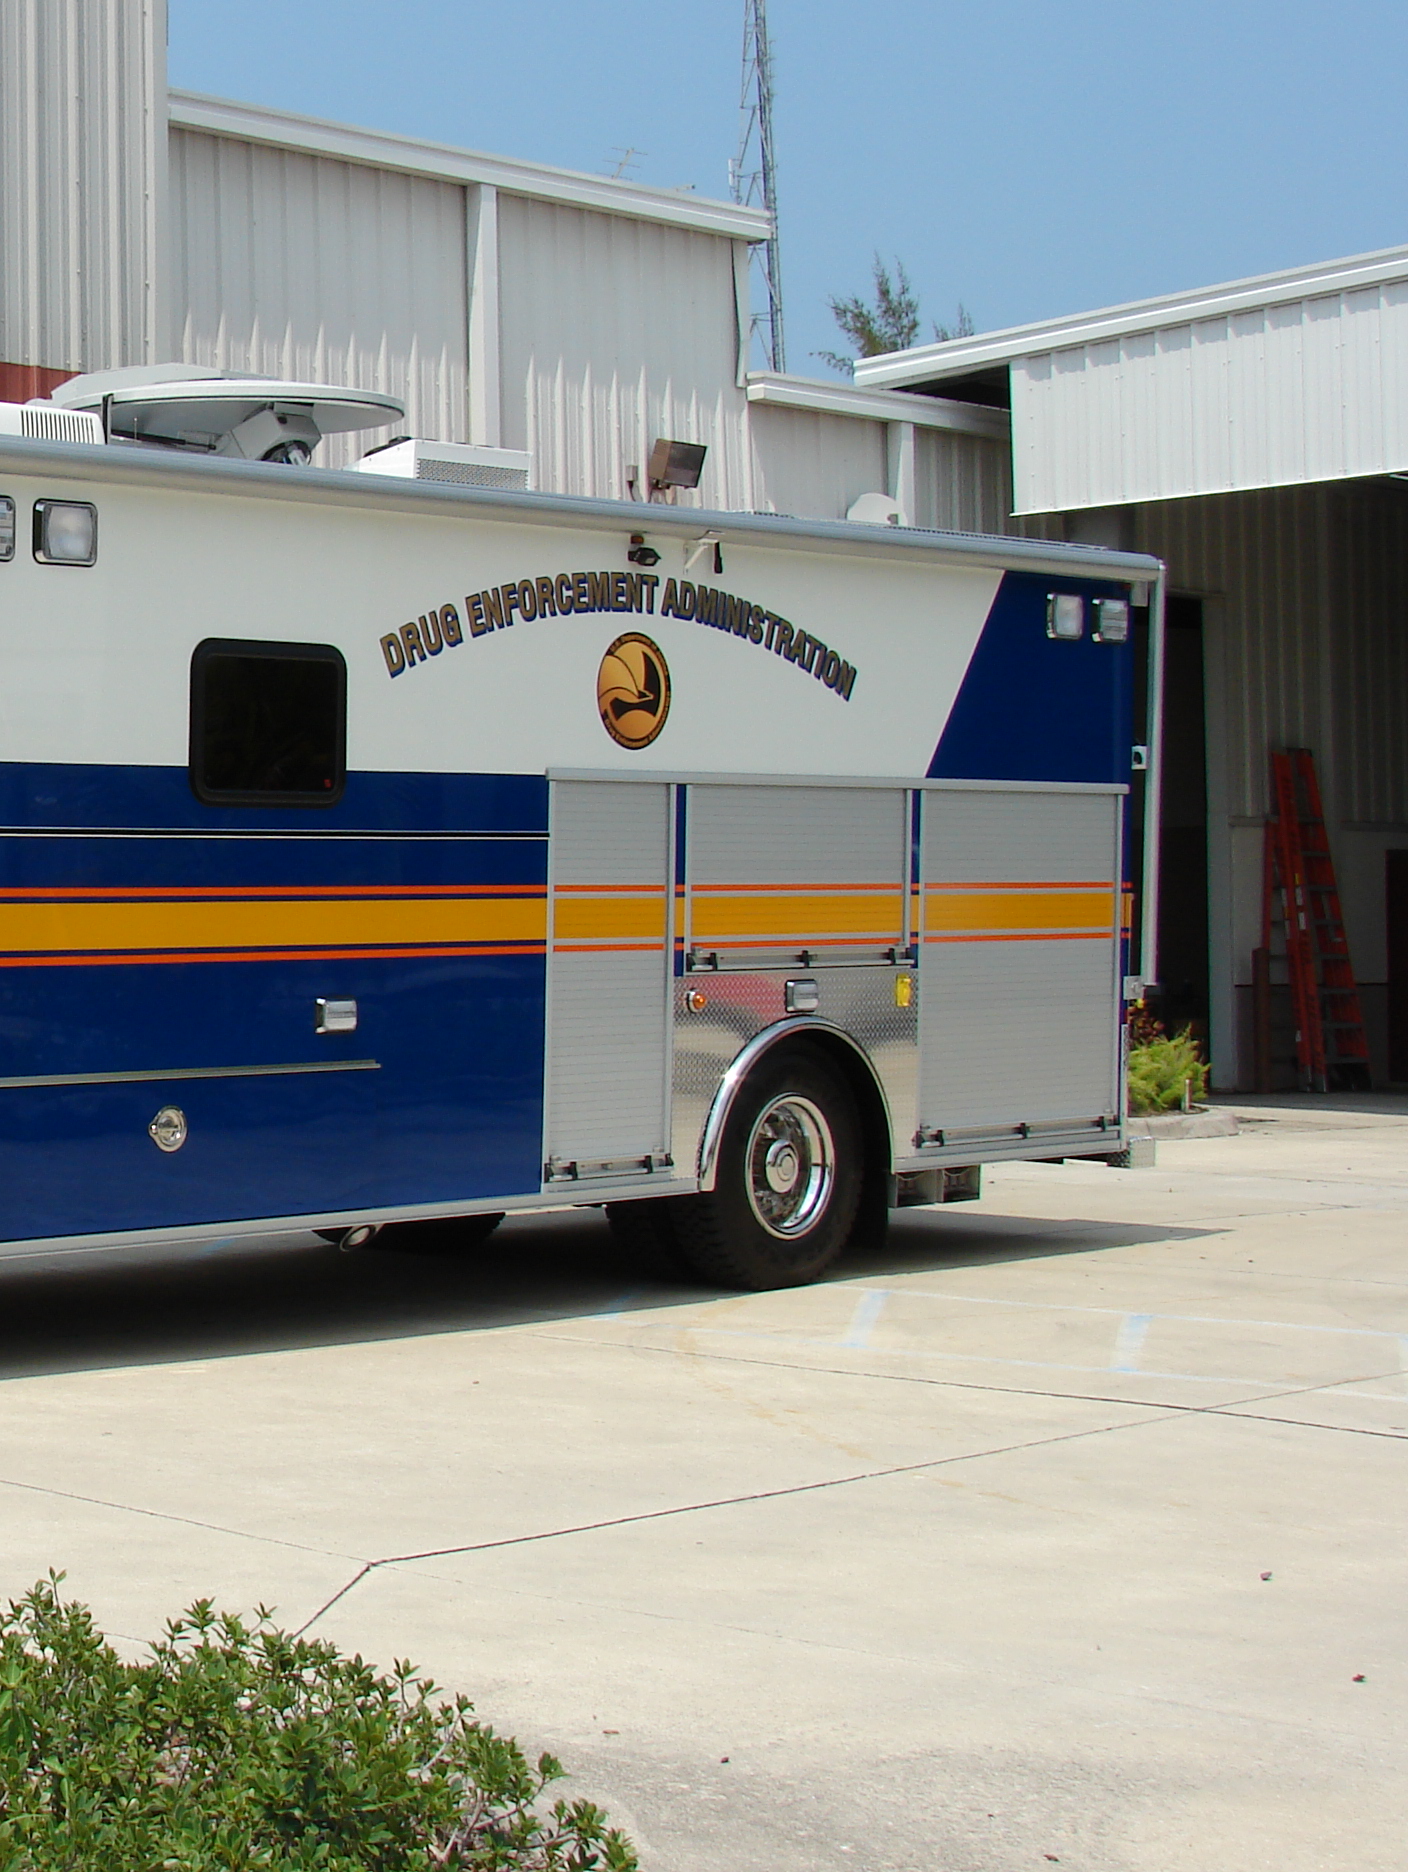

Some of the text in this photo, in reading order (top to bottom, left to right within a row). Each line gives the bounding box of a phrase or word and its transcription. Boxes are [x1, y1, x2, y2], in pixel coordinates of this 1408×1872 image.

[379, 603, 464, 679] DRUG
[465, 571, 659, 638] ENFORCEMENT
[660, 577, 857, 702] ADMINISTRATION
